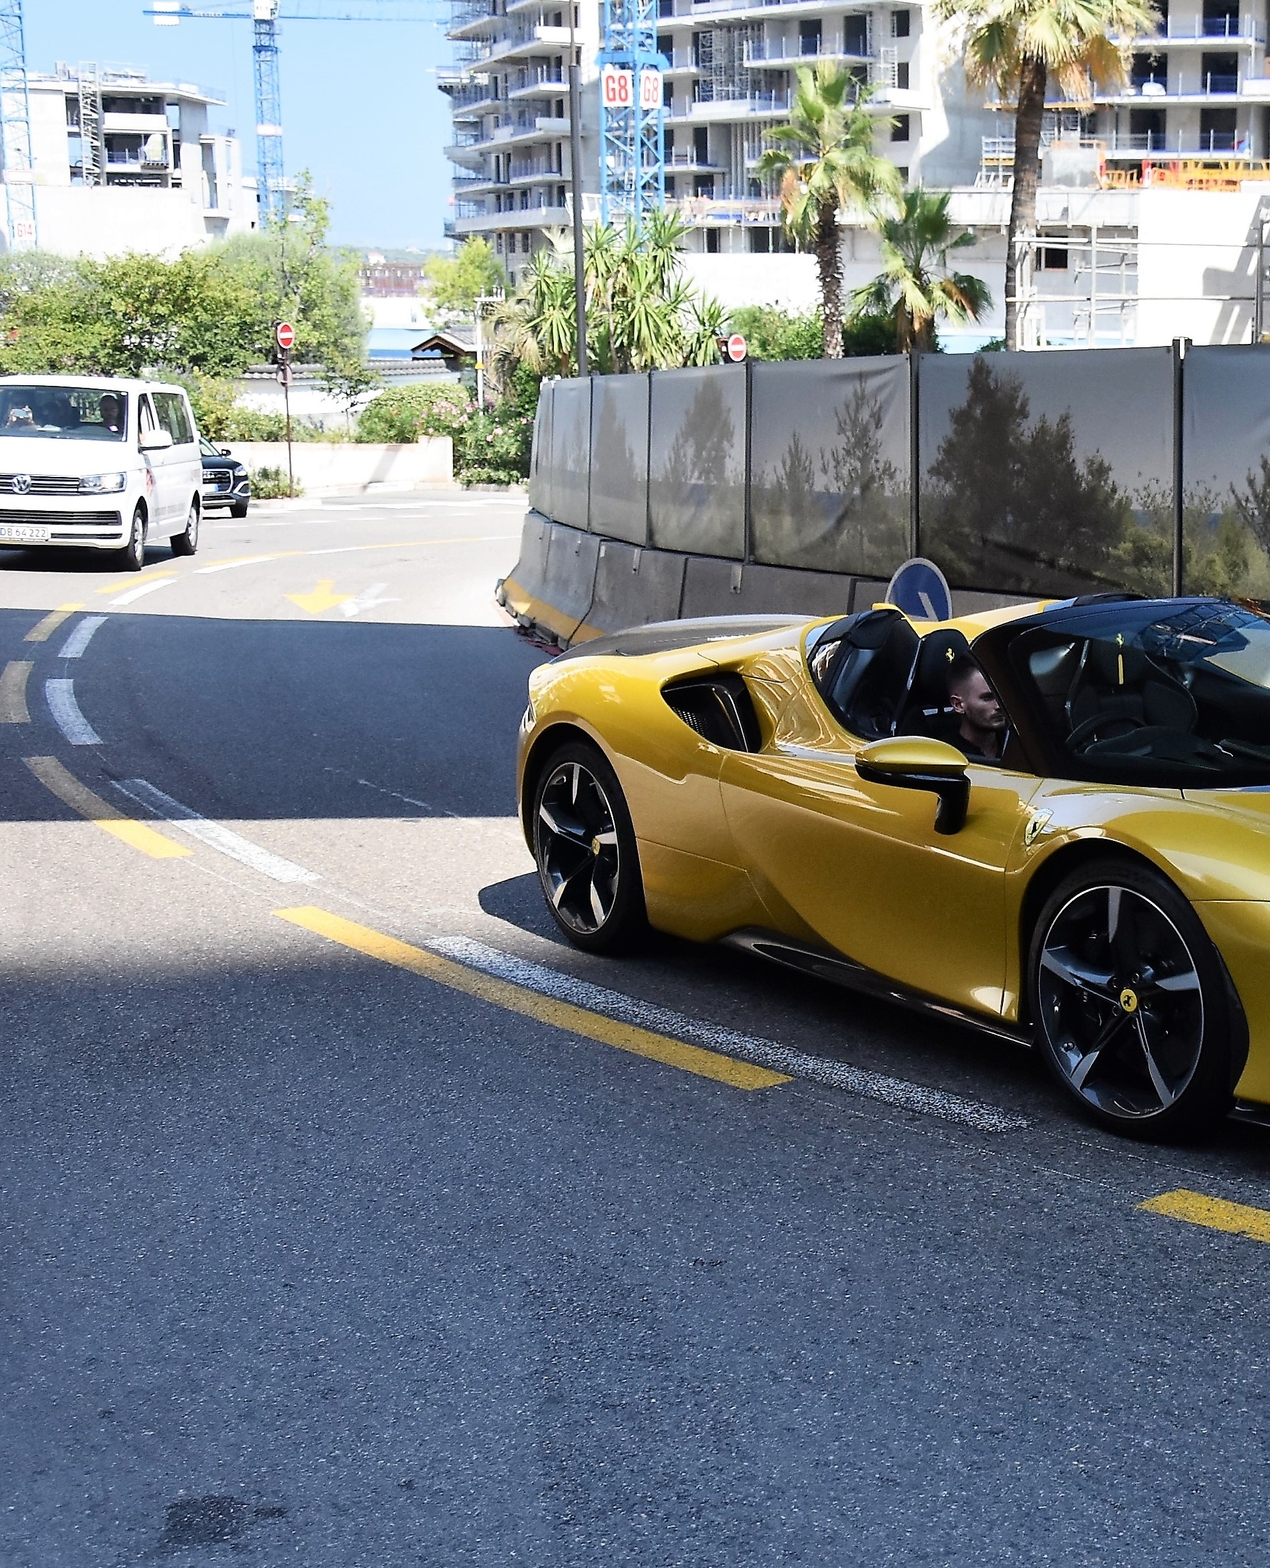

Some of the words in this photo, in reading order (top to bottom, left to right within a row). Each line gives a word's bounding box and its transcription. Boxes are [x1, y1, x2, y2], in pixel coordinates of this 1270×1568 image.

[605, 75, 628, 102] G8
[643, 76, 659, 103] G8
[17, 222, 33, 238] G14
[15, 528, 27, 537] 64
[29, 528, 46, 538] 222
